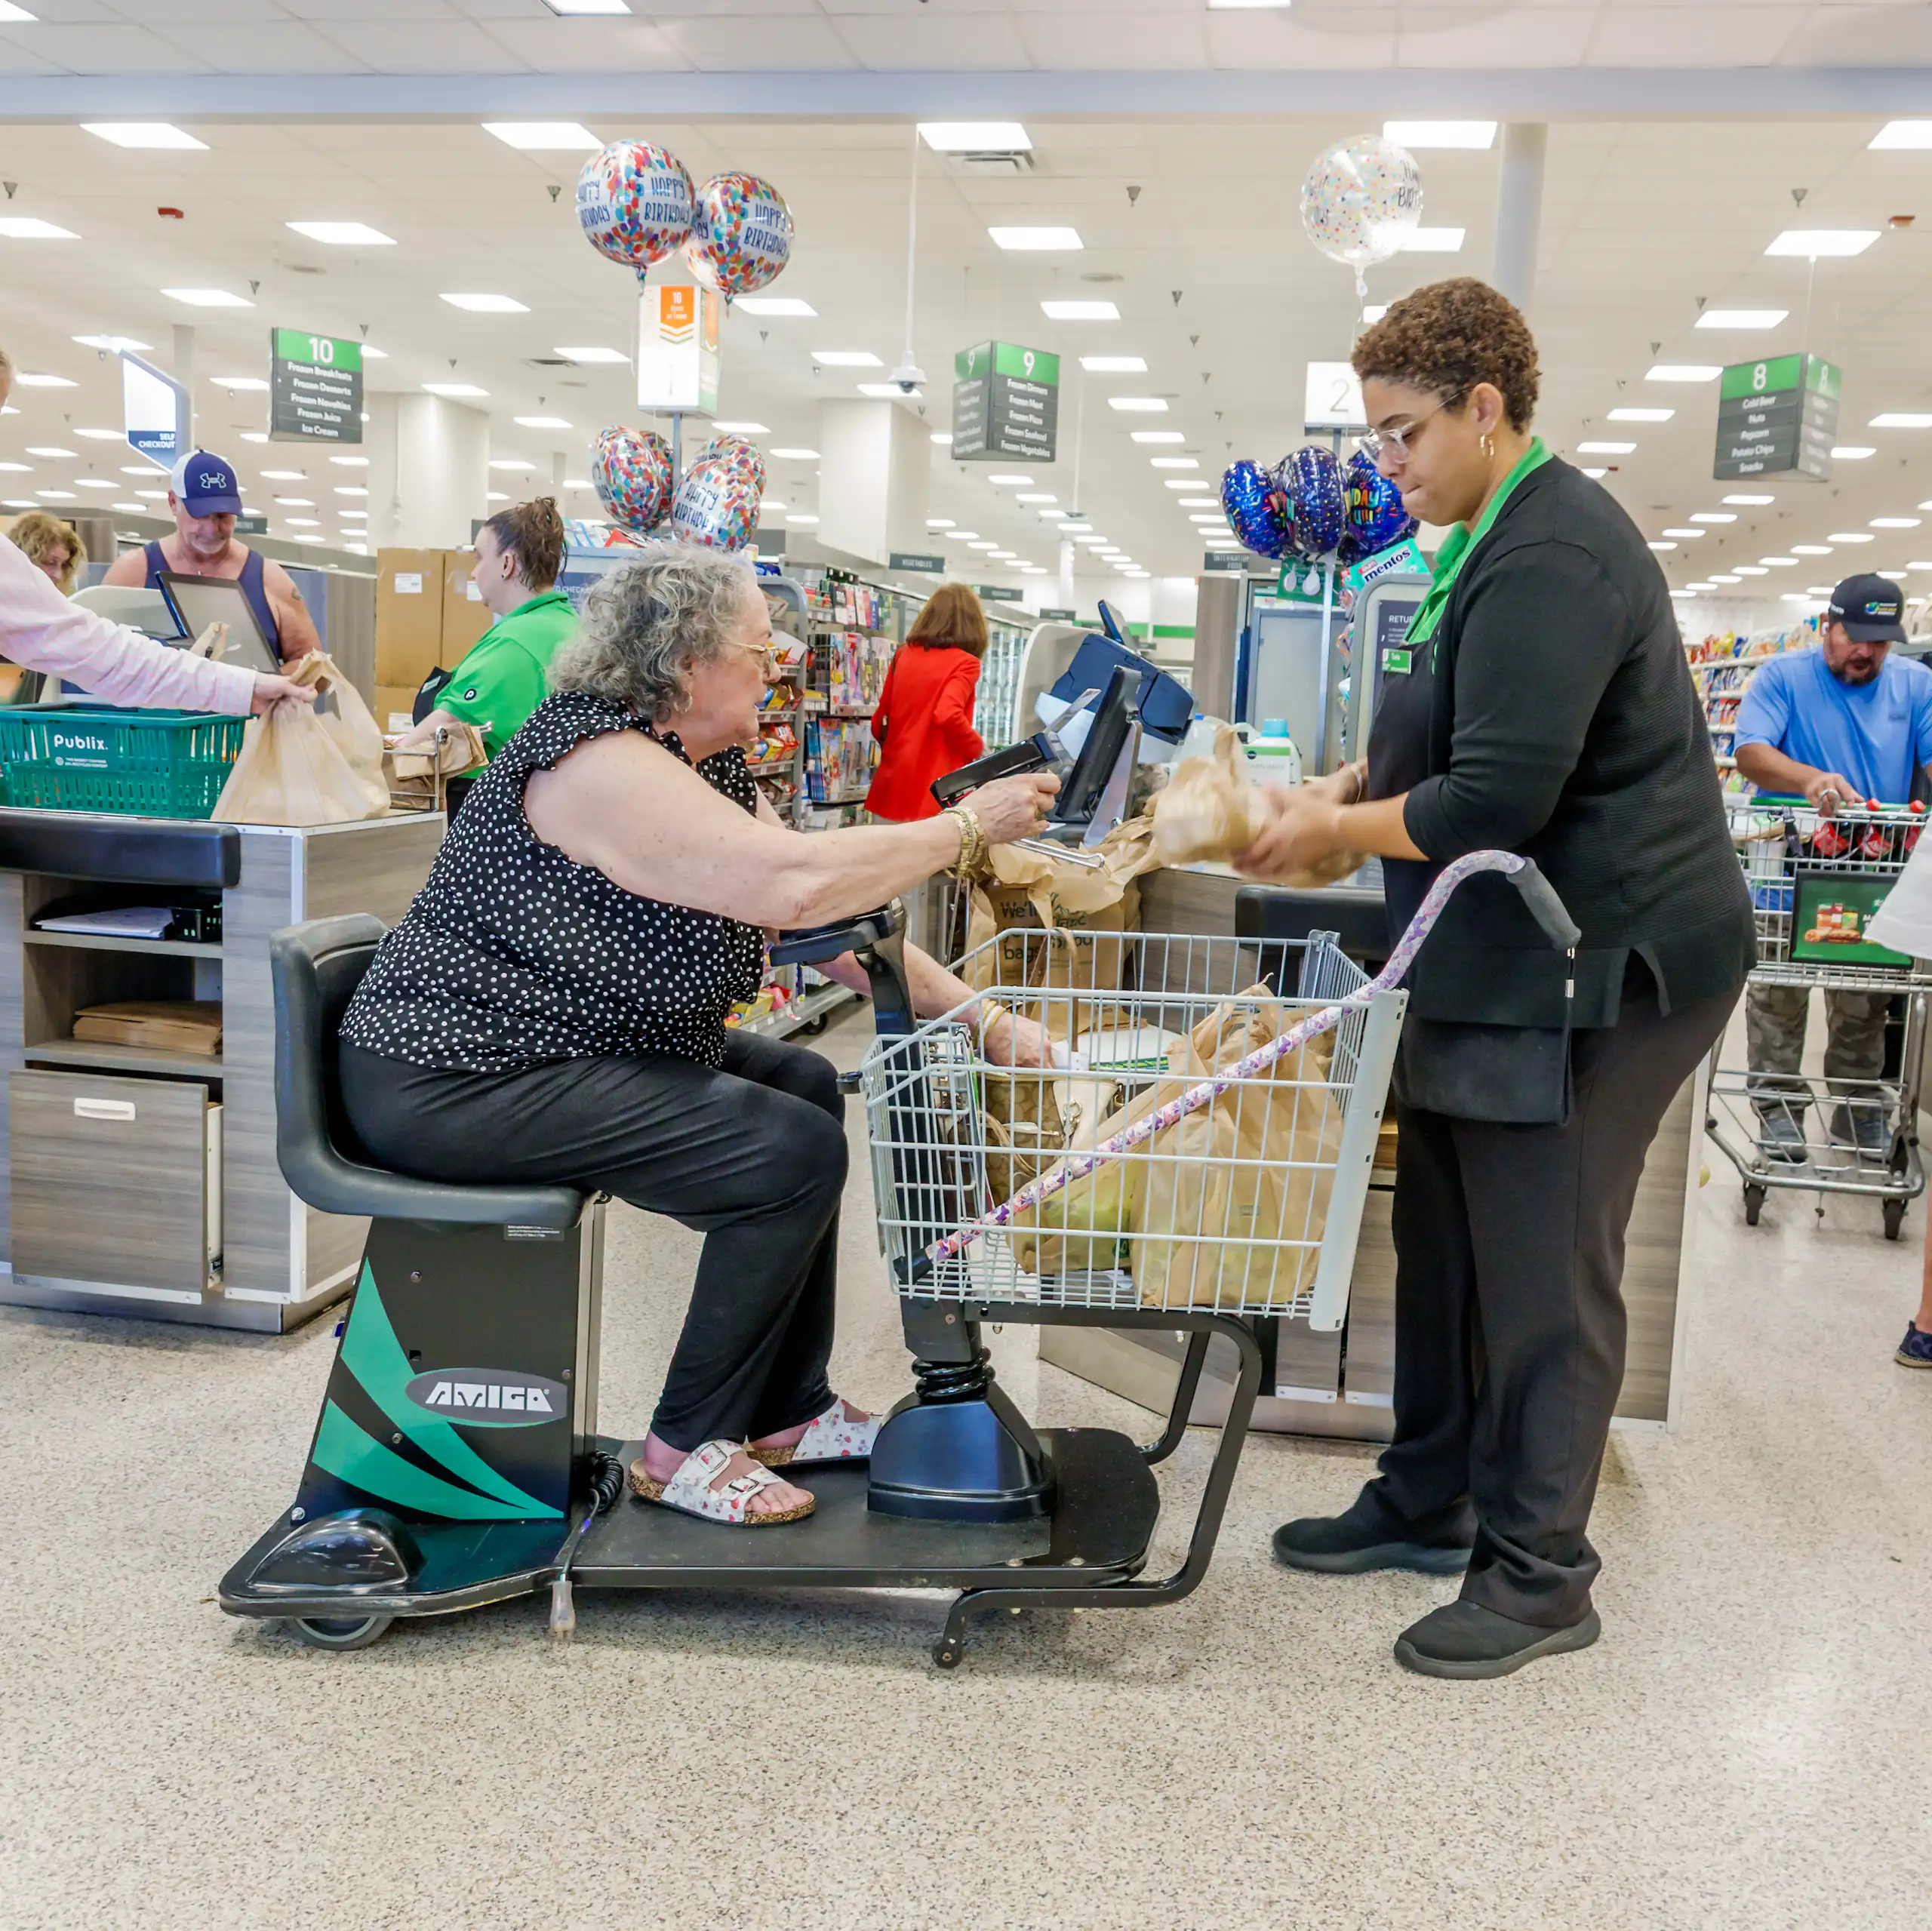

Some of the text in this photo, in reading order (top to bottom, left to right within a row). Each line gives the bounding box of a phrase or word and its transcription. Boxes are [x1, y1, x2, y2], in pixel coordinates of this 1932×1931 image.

[651, 177, 685, 201] HAPPY
[645, 201, 690, 224] BIRTHDAY
[755, 203, 786, 232] HAPPY
[742, 226, 787, 257] BIRTHDAY
[672, 291, 682, 304] 10
[309, 337, 334, 364] 10
[288, 361, 314, 374] Frozen
[968, 351, 975, 375] 9
[1023, 351, 1035, 376] 9
[293, 377, 318, 390] Frozen
[1752, 363, 1767, 391] 8
[1007, 378, 1026, 391] Frozen
[291, 392, 317, 405] Frozen
[1008, 394, 1029, 407] Frozen
[1330, 378, 1350, 413] 2
[1742, 398, 1759, 410] Cold
[297, 407, 323, 420] Frozen
[1008, 410, 1029, 422] Frozen
[1748, 414, 1766, 424] Nuts
[158, 432, 175, 441] SELF
[302, 423, 339, 438] Ice Cream
[1004, 425, 1047, 442] Frozen Seafood
[1740, 429, 1770, 441] Popcorn
[138, 440, 175, 449] CHECKOUT
[1001, 440, 1020, 452] Frozen
[1731, 444, 1774, 458] Potato Chips
[1739, 462, 1764, 473] Snacks
[685, 482, 718, 511] HAPPY
[1364, 549, 1411, 583] mentos
[425, 1381, 553, 1413] AMIGA
